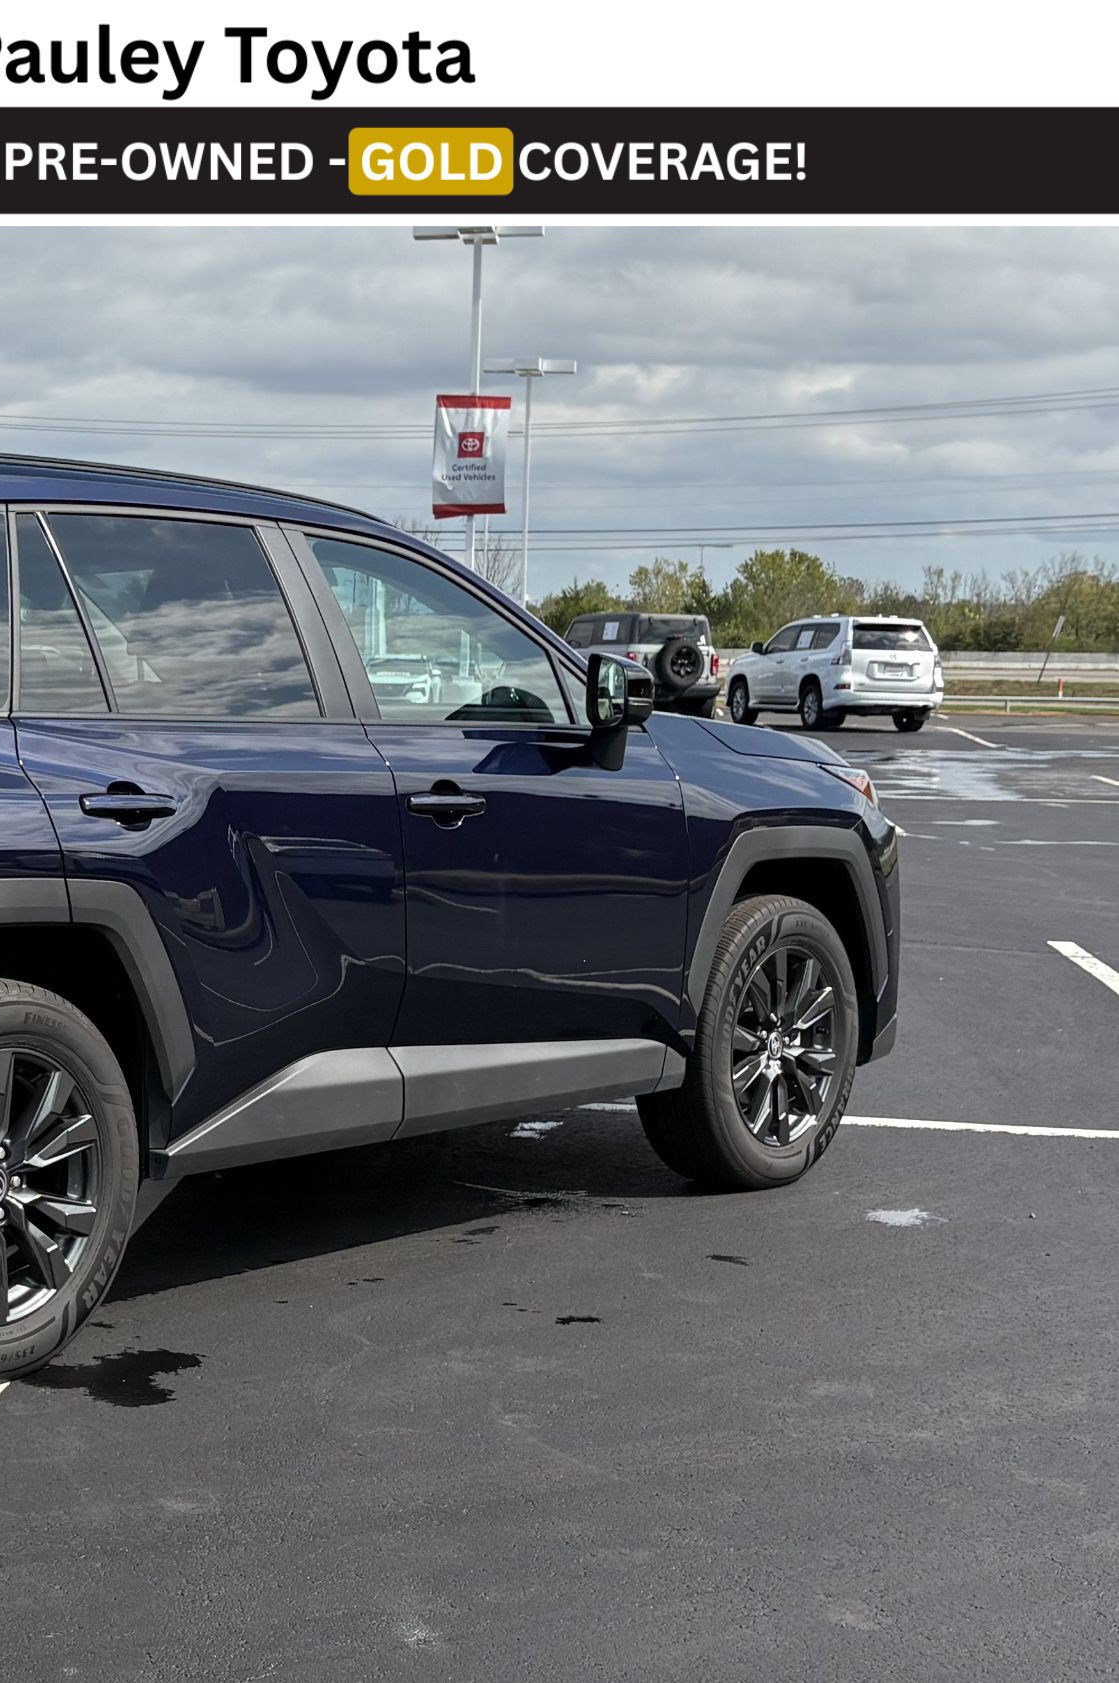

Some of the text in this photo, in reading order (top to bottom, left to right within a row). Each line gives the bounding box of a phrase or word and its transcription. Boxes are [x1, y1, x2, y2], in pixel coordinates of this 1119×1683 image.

[451, 463, 487, 471] Certified
[441, 473, 496, 481] Used Vehicles
